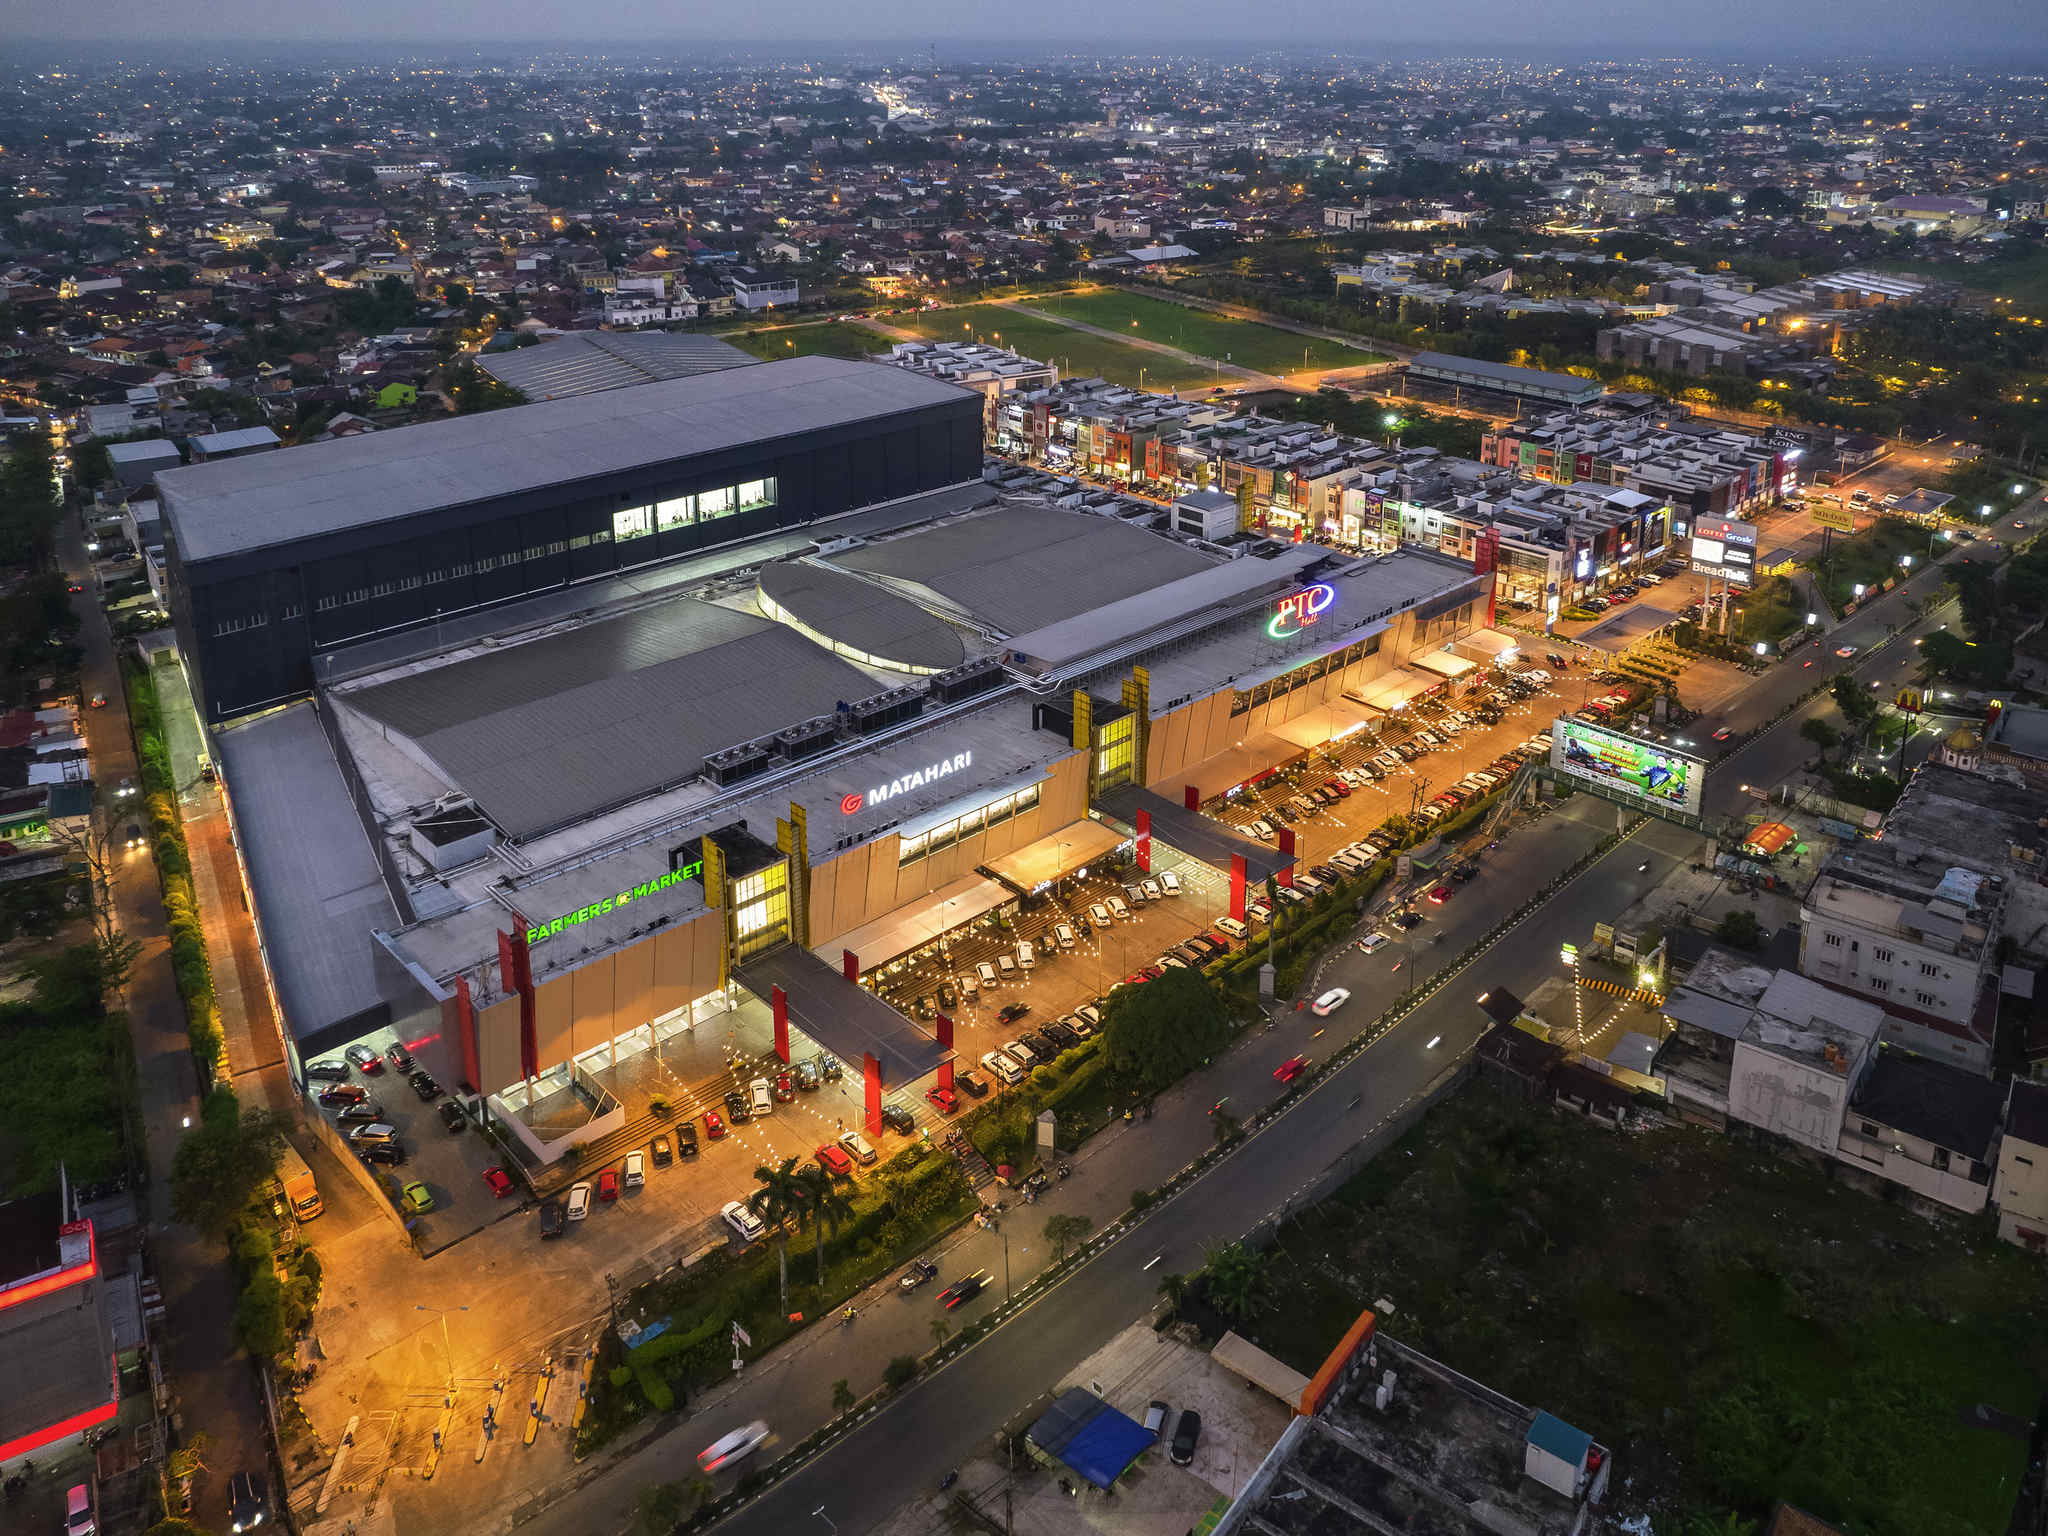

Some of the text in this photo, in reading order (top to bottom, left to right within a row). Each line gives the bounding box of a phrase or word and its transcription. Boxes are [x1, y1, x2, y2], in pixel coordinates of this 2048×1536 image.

[1775, 429, 1805, 440] KING
[1697, 528, 1725, 540] LOTTE
[1692, 561, 1749, 583] BreadTalk
[869, 751, 971, 806] MATAHARI
[527, 860, 703, 945] FARMERS MARKET
